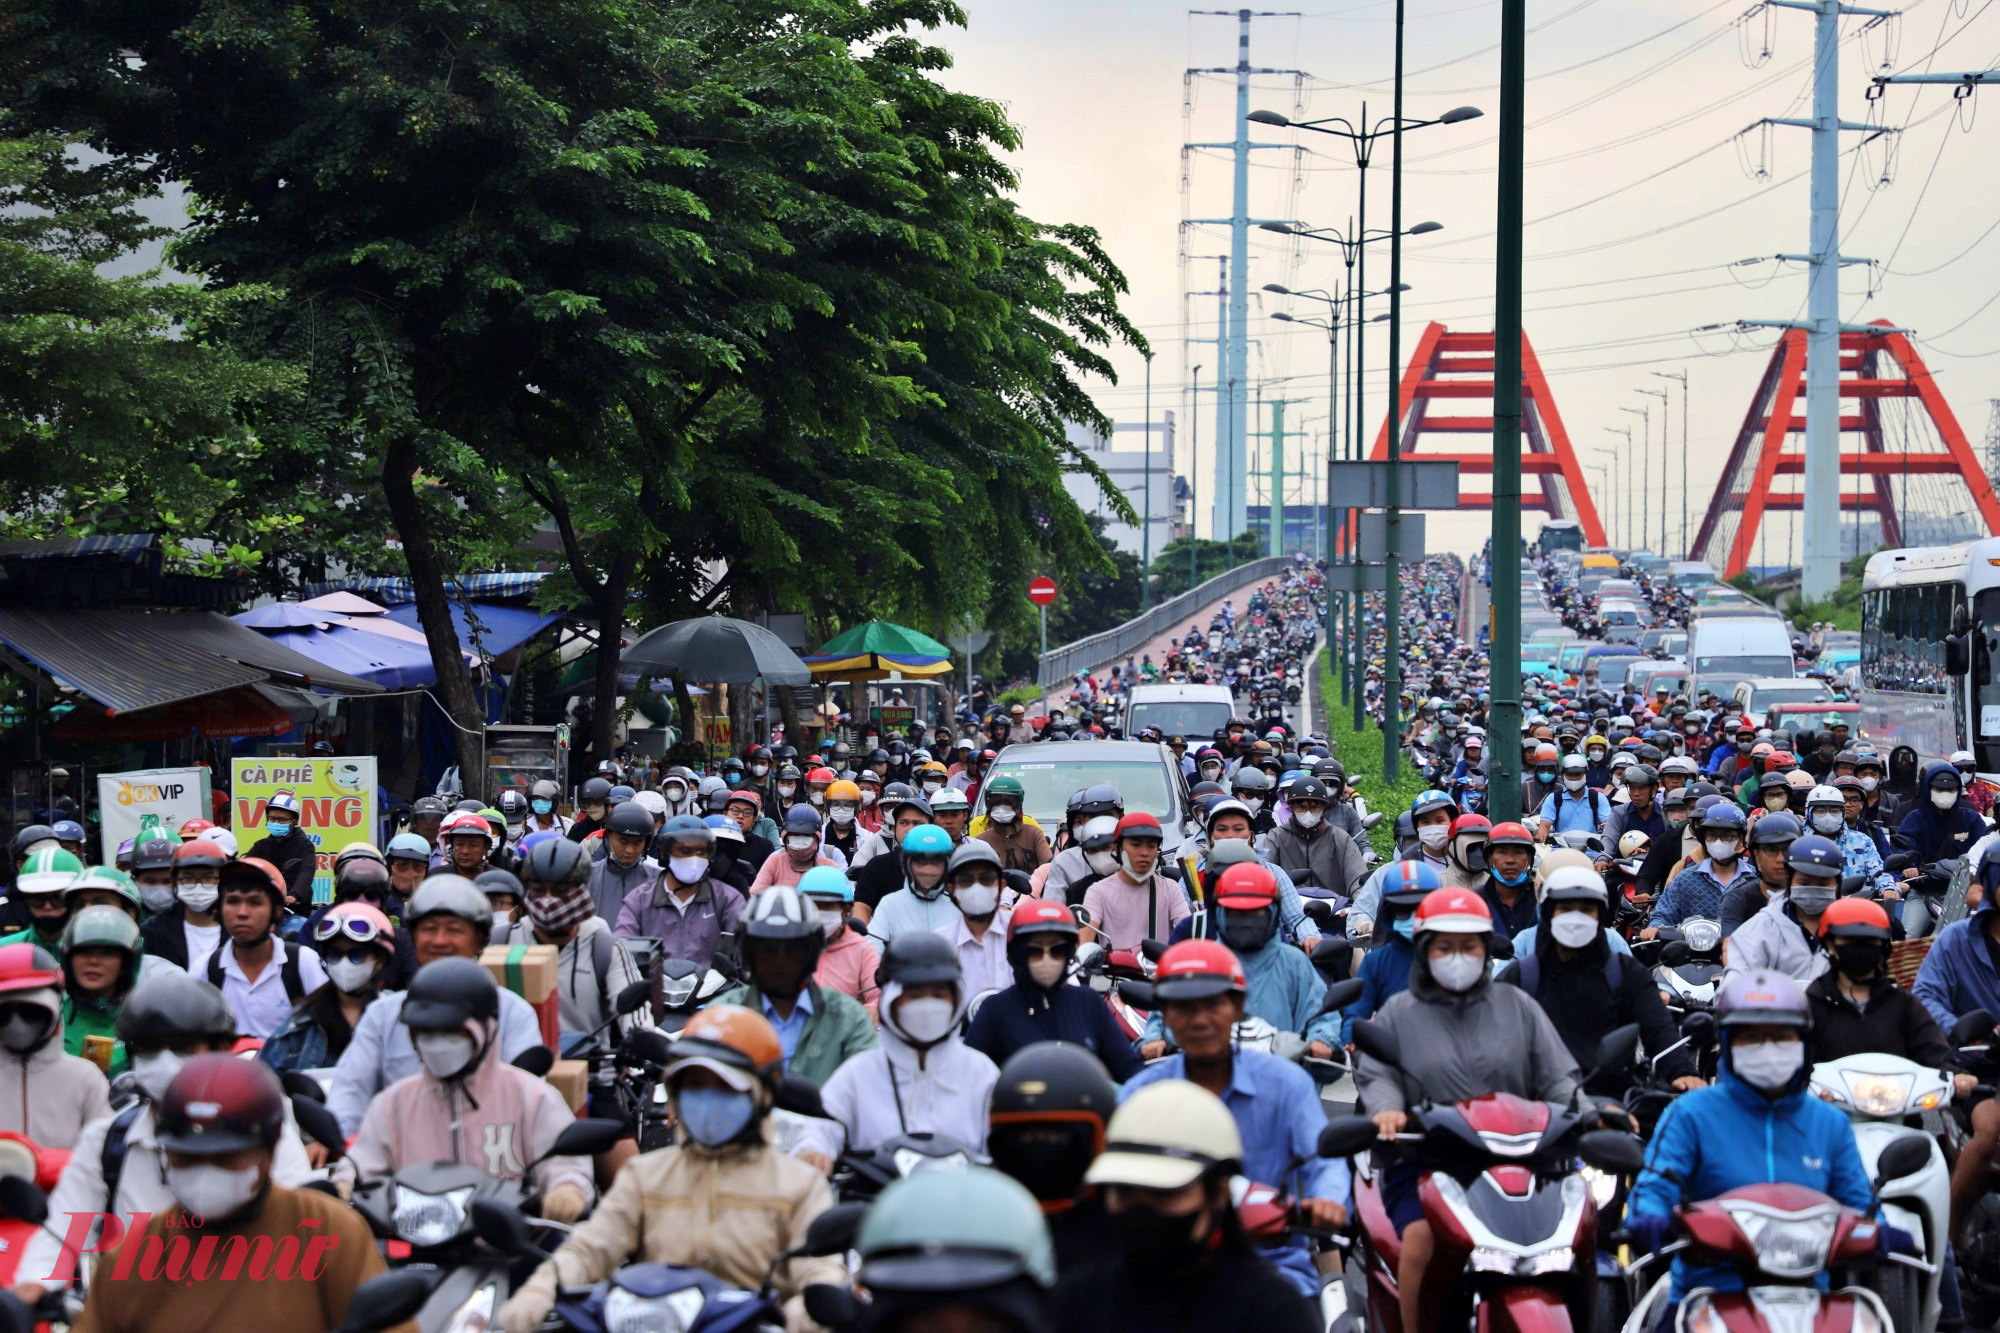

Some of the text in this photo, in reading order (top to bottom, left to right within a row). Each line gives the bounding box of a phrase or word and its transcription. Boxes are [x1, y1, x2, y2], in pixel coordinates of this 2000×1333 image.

[240, 764, 313, 783] CÀ PHÊ
[236, 787, 363, 829] VNG
[140, 813, 159, 831] 79
